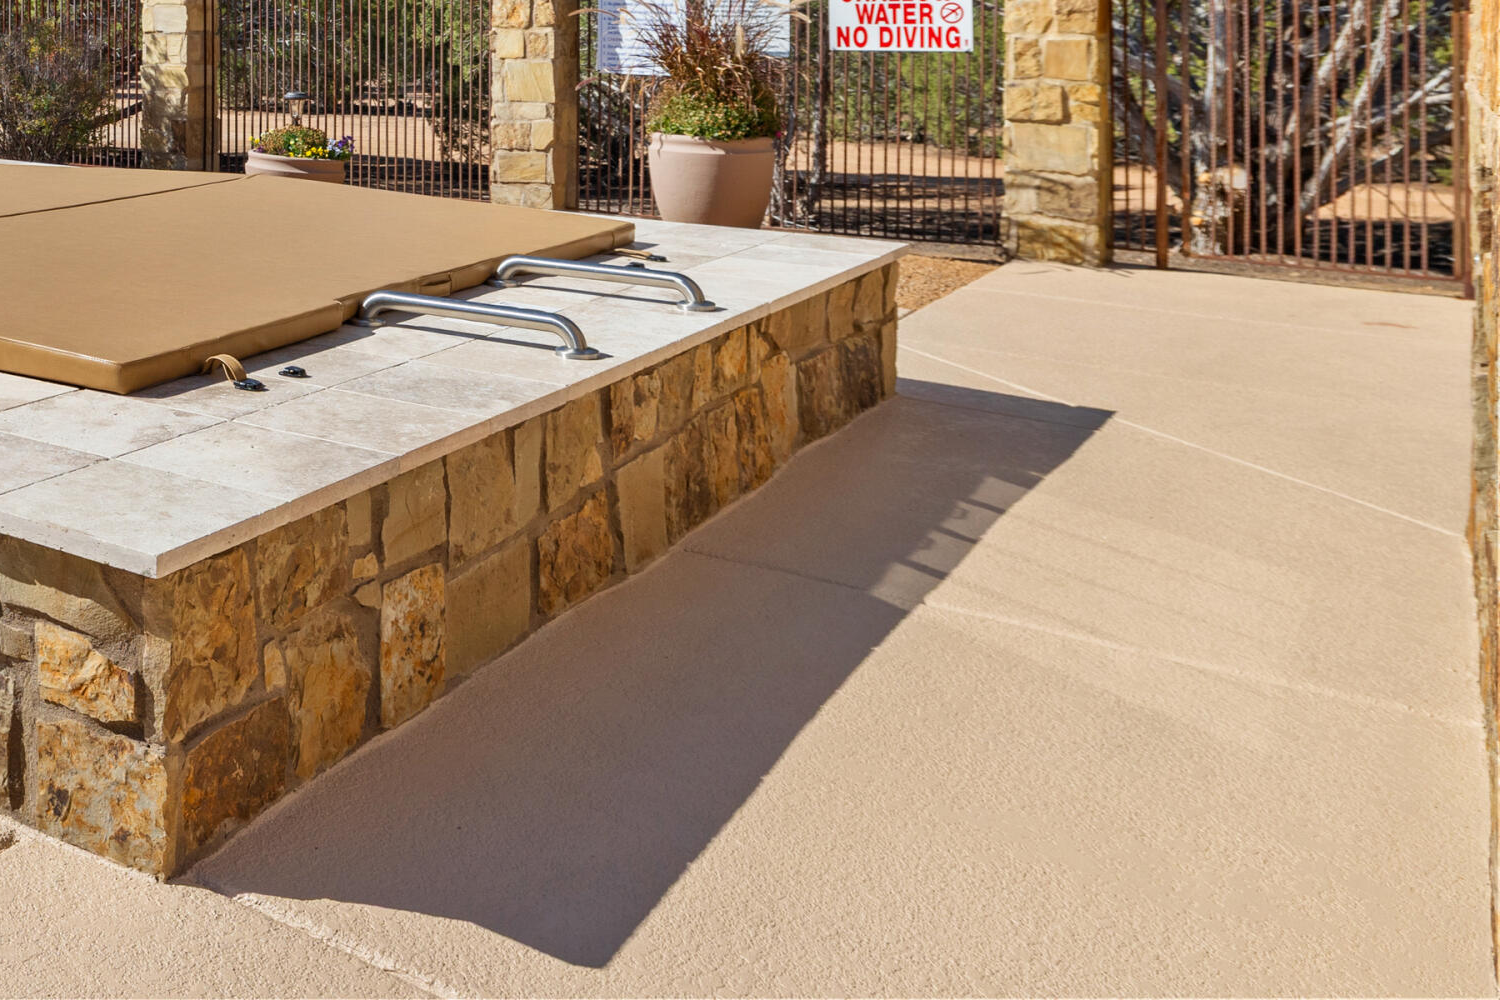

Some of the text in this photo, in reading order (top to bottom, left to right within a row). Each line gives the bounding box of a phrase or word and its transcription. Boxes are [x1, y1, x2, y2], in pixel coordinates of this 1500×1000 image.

[855, 2, 934, 25] WATER
[836, 25, 962, 49] NO DIVING
